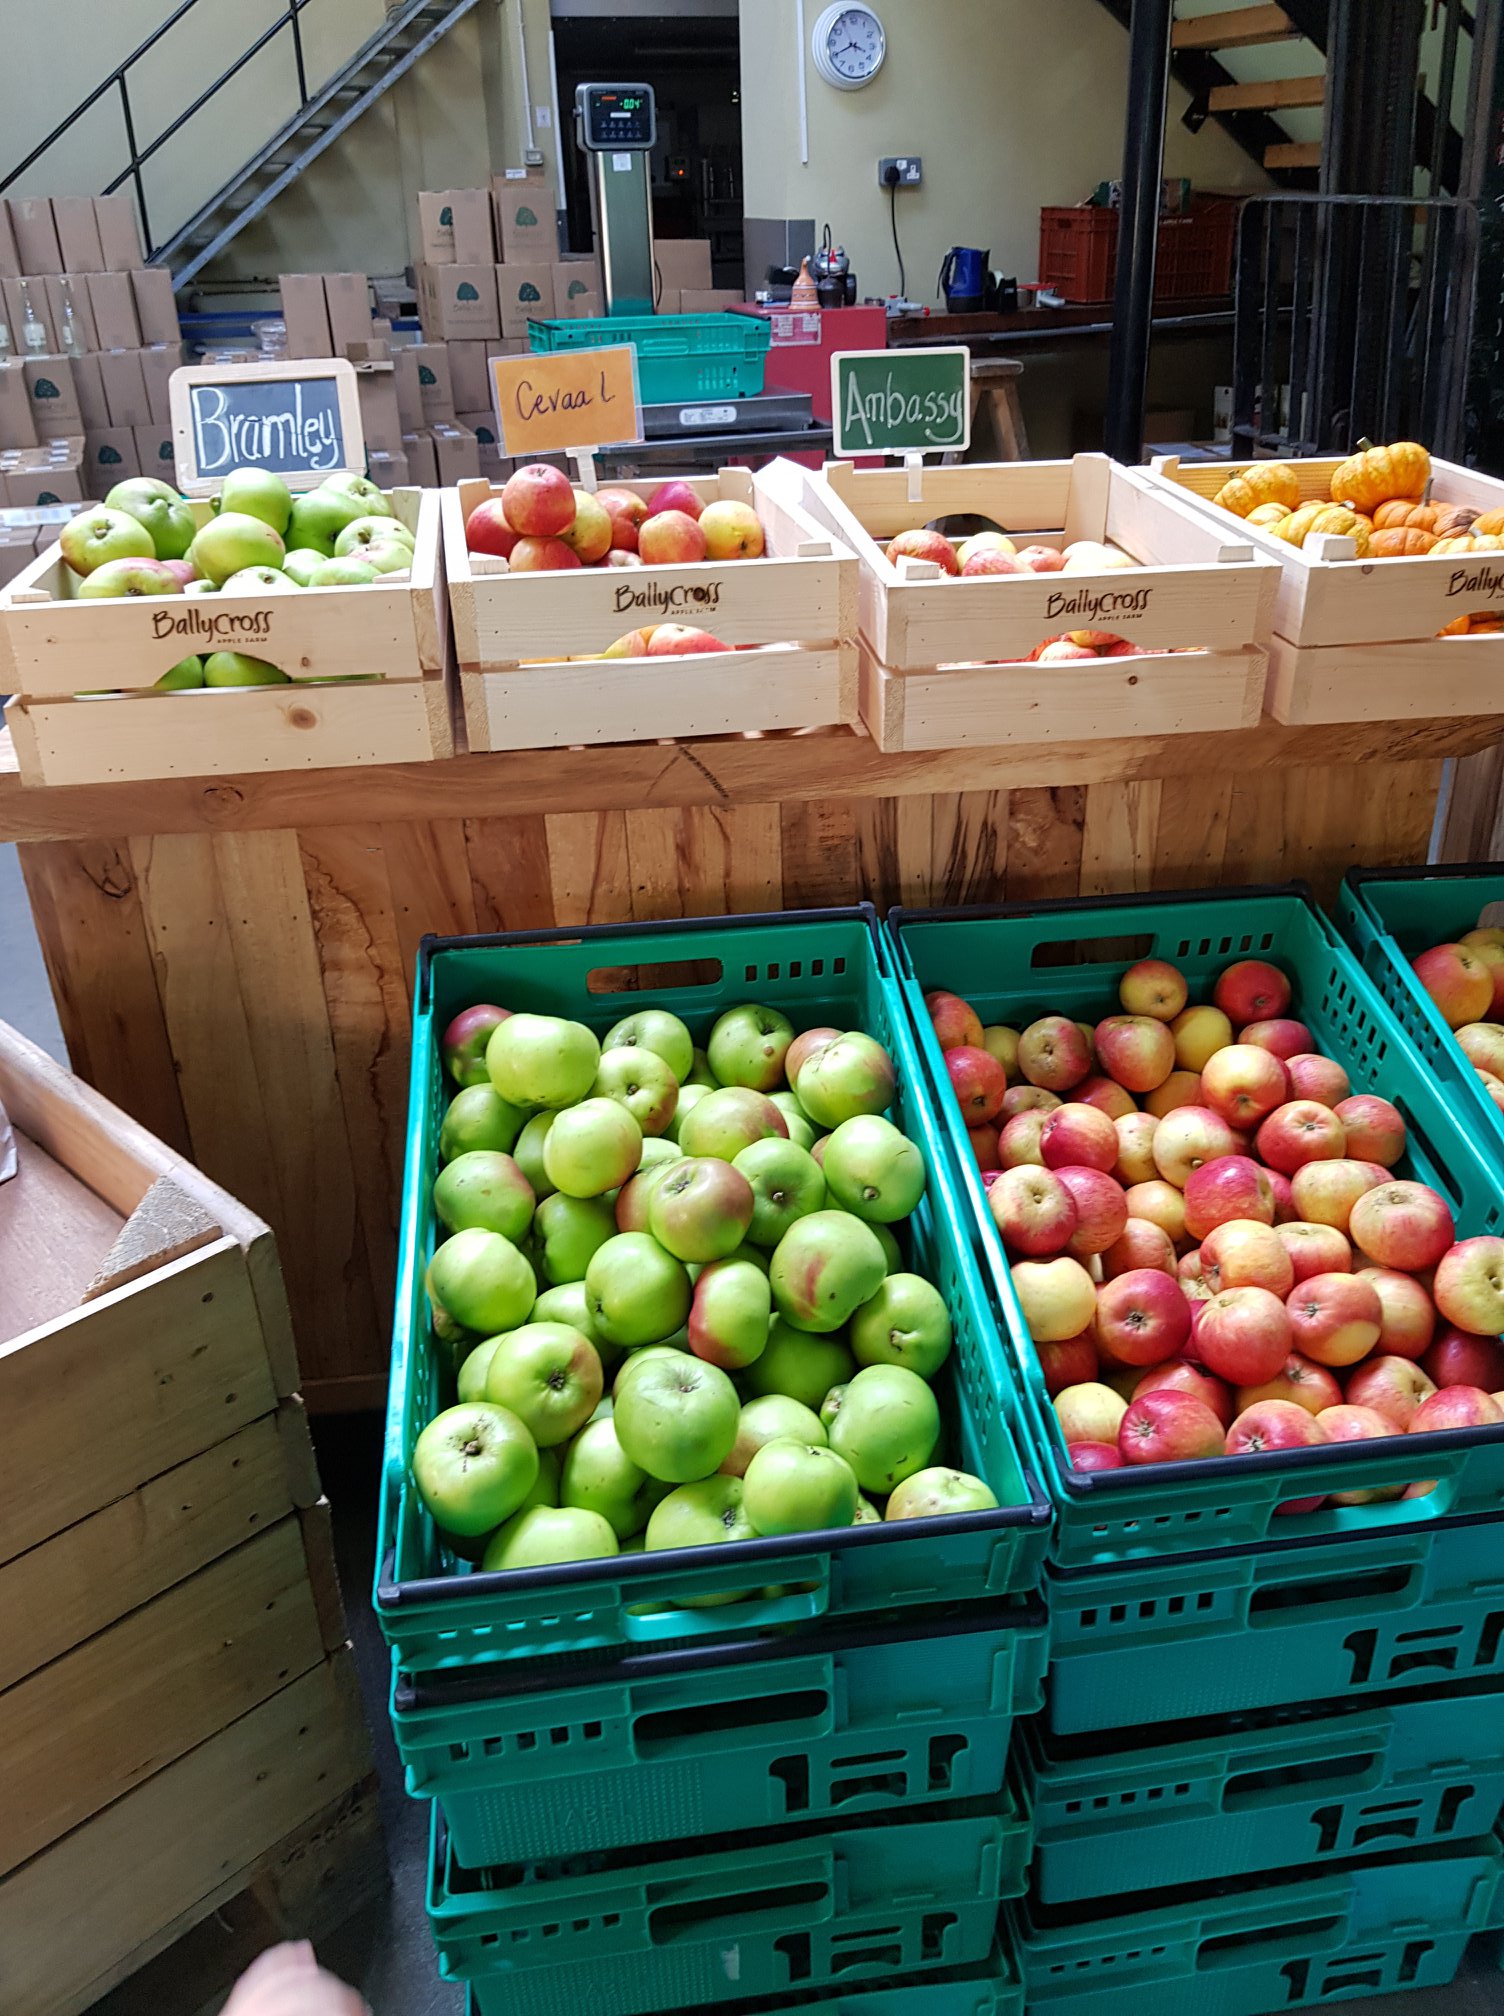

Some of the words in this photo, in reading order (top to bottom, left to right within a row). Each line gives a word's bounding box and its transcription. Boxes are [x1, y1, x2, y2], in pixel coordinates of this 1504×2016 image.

[845, 371, 963, 445] Ambassy
[191, 383, 340, 470] Bramley
[613, 582, 723, 615] BallyCross
[1043, 589, 1153, 621] BallyCross
[152, 608, 274, 643] BallyCross
